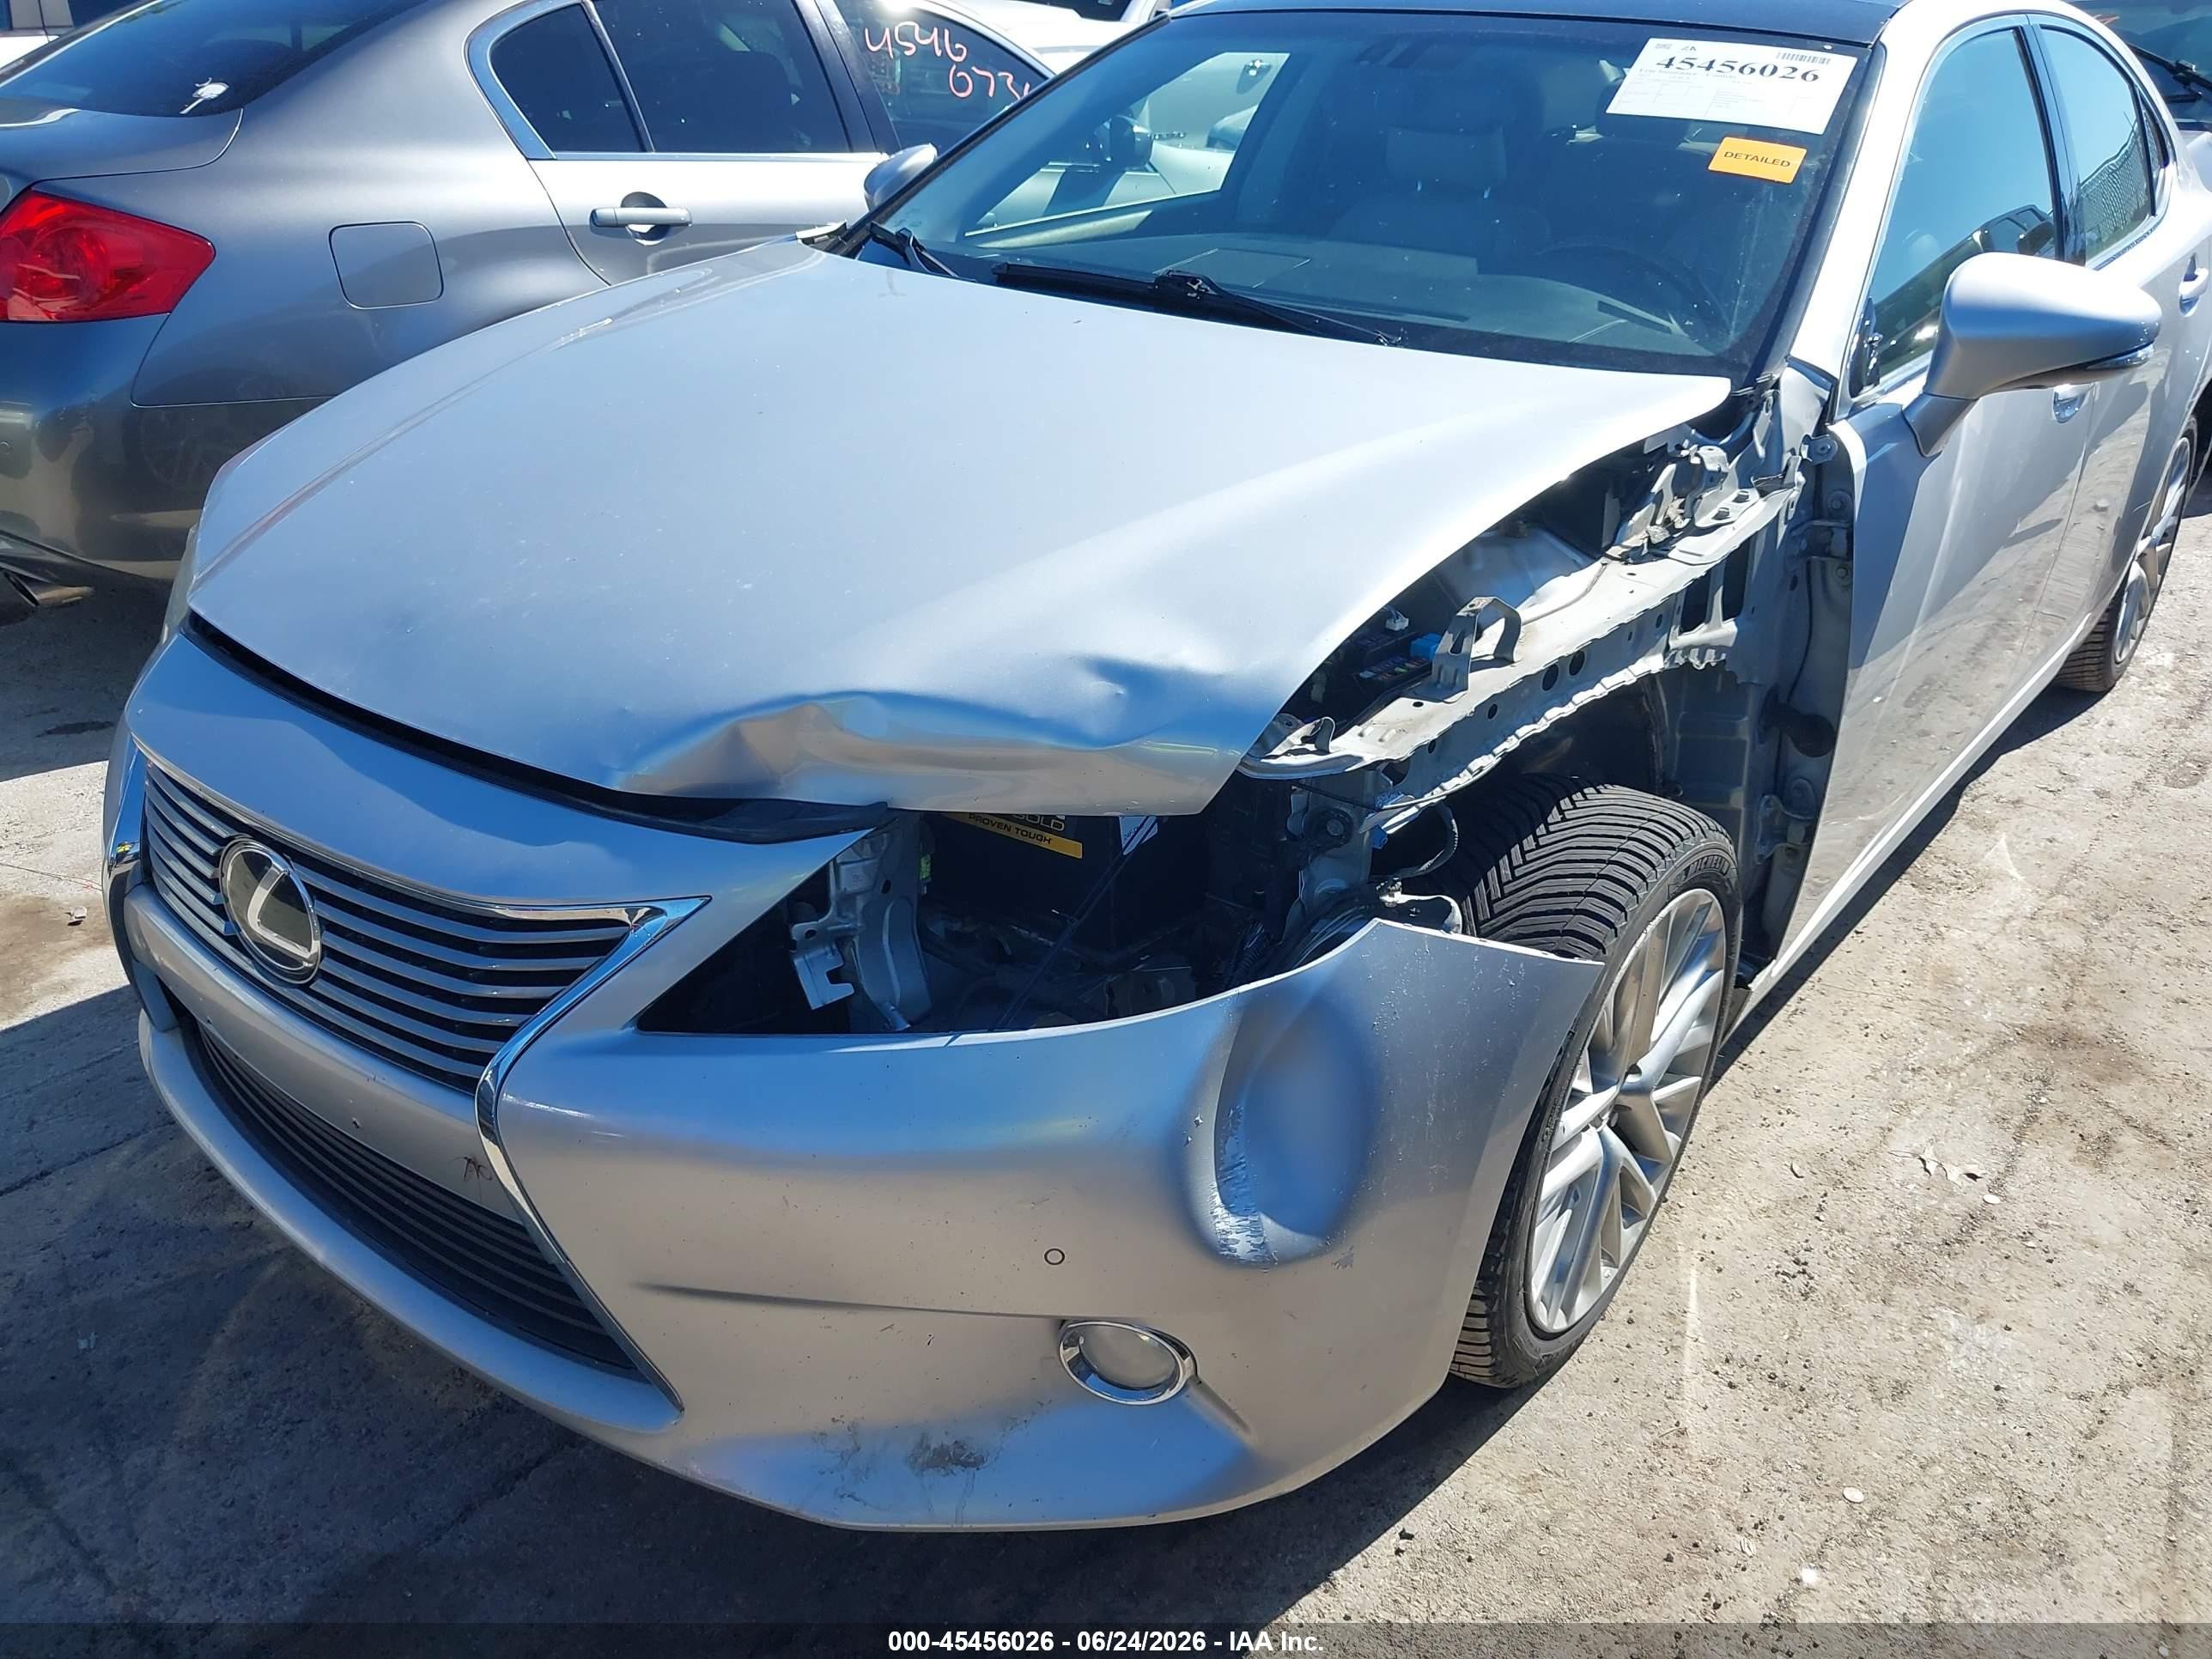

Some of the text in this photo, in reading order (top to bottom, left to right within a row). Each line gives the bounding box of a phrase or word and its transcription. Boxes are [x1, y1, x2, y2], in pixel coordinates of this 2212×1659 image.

[864, 21, 968, 62] 4546
[1655, 55, 1820, 83] 45456026
[1723, 149, 1791, 168] DETAILED
[968, 812, 1052, 844] PROVEN TOUGH
